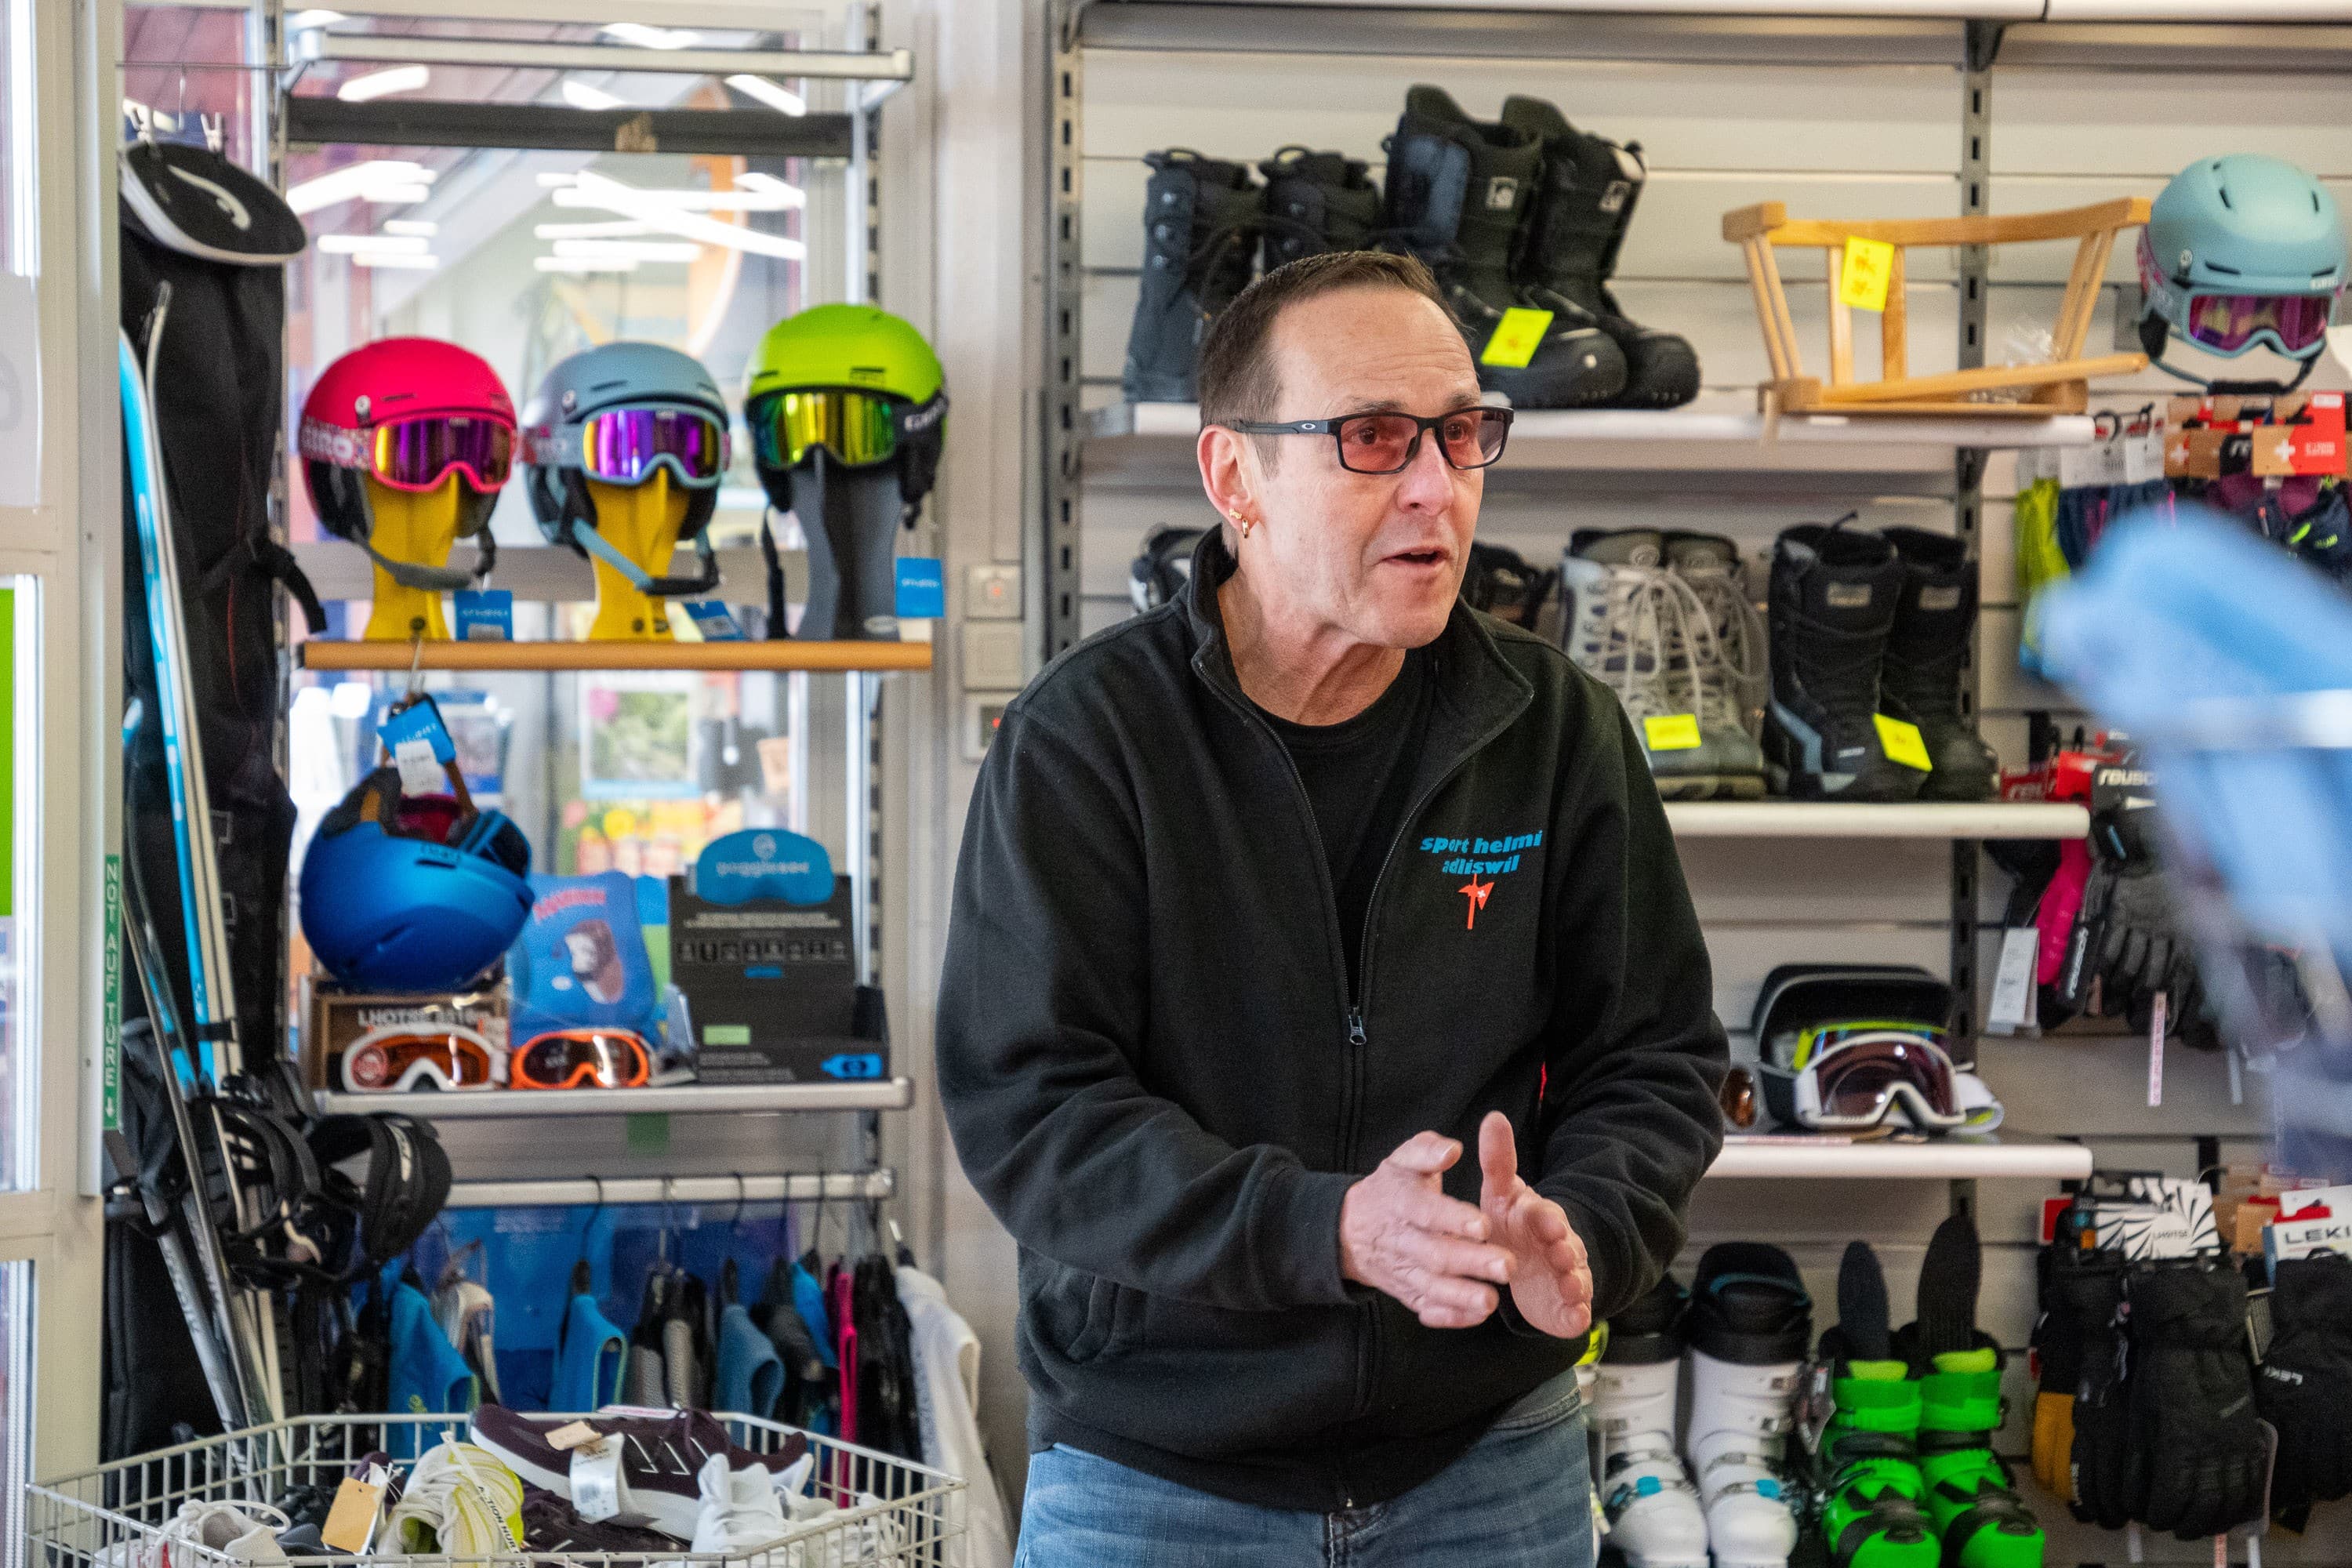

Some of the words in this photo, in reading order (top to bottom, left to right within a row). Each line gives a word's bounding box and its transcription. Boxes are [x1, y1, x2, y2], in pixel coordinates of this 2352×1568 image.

[1419, 837, 1470, 855] sport
[1473, 829, 1544, 855] helmi
[105, 863, 118, 924] NOT
[104, 933, 118, 994] AUF
[2285, 1224, 2352, 1245] LEKI
[477, 1486, 504, 1523] ATION
